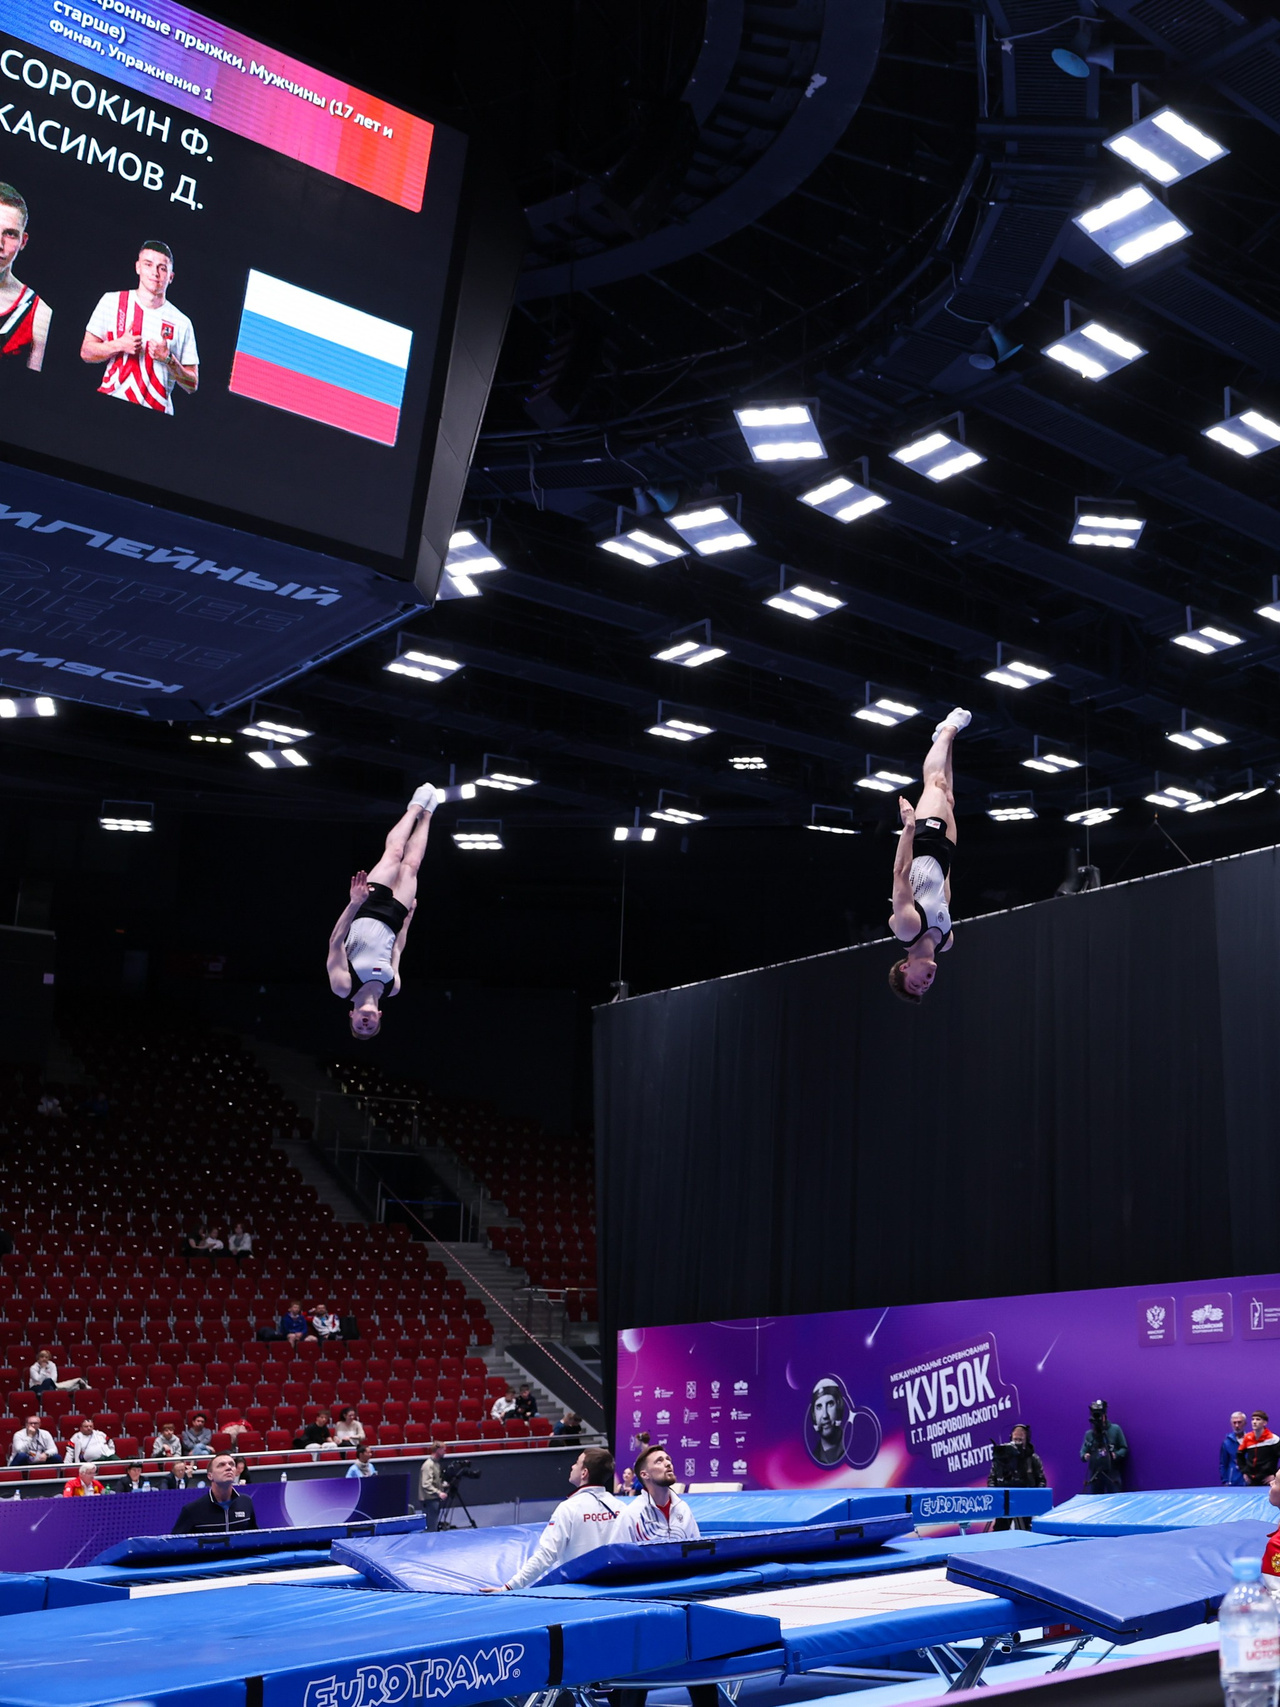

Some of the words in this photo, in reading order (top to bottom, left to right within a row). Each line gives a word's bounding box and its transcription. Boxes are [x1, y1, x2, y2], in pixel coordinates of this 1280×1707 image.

[53, 0, 127, 44] старше)
[49, 19, 106, 56] Финал,
[107, 43, 202, 97] Упражнение
[203, 88, 213, 102] 1
[0, 49, 171, 144] СОРОКИН
[180, 127, 214, 163] Ф.
[174, 28, 247, 74] прыжки,
[249, 59, 327, 109] Мужчины
[328, 98, 354, 120] (17
[353, 112, 382, 134] лет
[382, 126, 394, 140] и
[169, 174, 204, 211] Д.
[890, 1359, 942, 1382] МЕЖДУНАРОДНЫЕ
[942, 1342, 990, 1364] СОРЕВНОВАНИЯ
[931, 1432, 972, 1460] ПРЫЖКИ
[947, 1453, 962, 1473] НА
[961, 1444, 995, 1469] БАТУТЕ
[303, 1643, 525, 1707] EUROTRAMP
